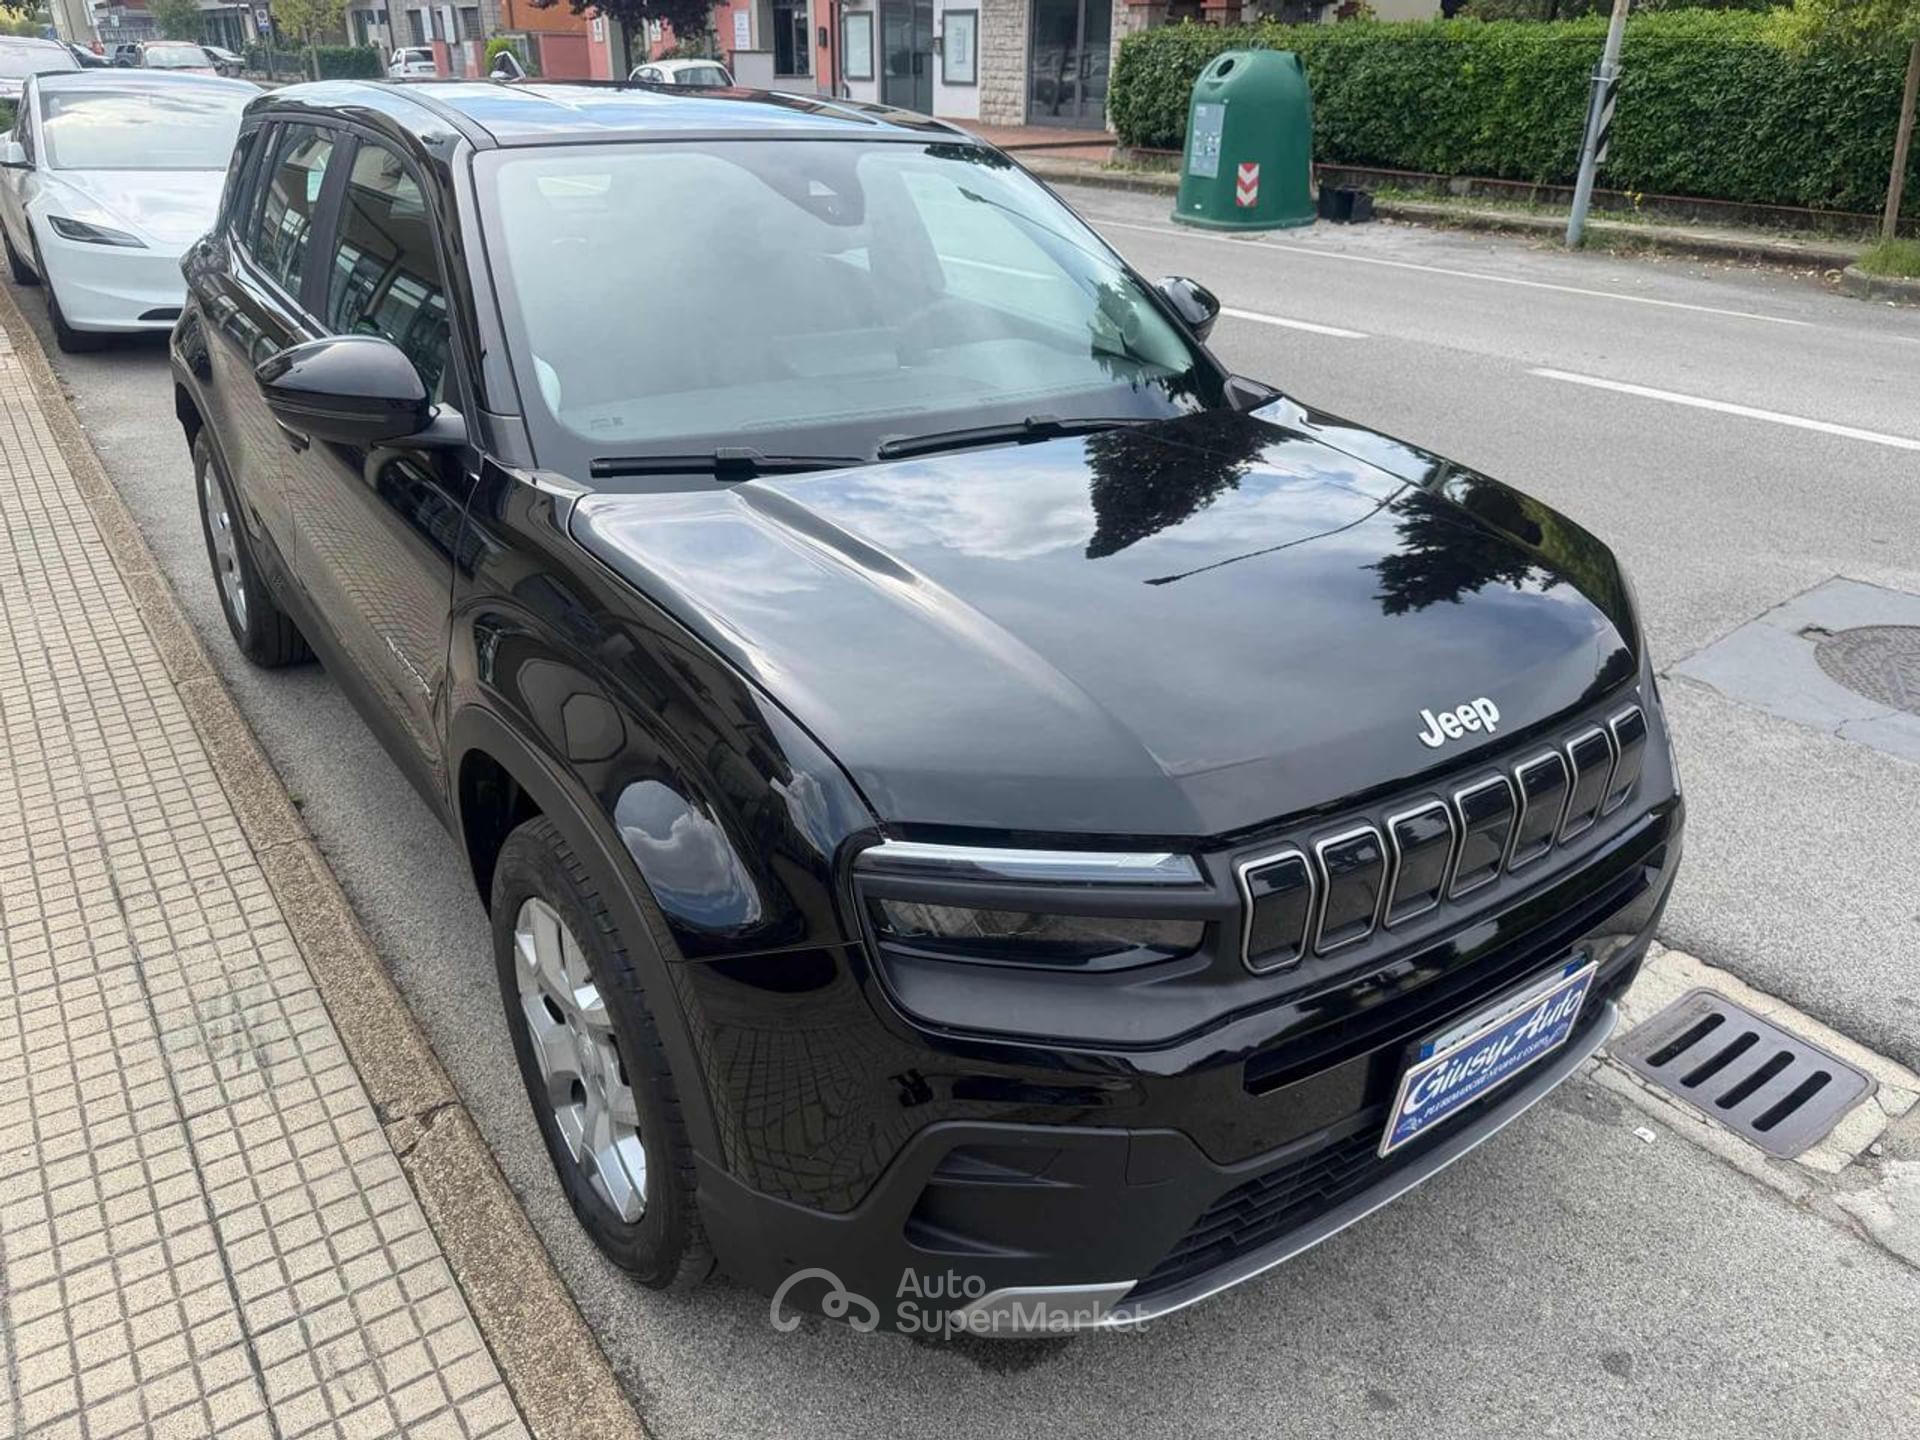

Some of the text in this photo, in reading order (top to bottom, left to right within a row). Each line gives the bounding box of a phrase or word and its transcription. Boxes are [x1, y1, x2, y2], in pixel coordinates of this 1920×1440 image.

[1418, 697, 1500, 747] Jeep
[1403, 1036, 1508, 1115] Giusy
[1502, 989, 1582, 1056] Auto
